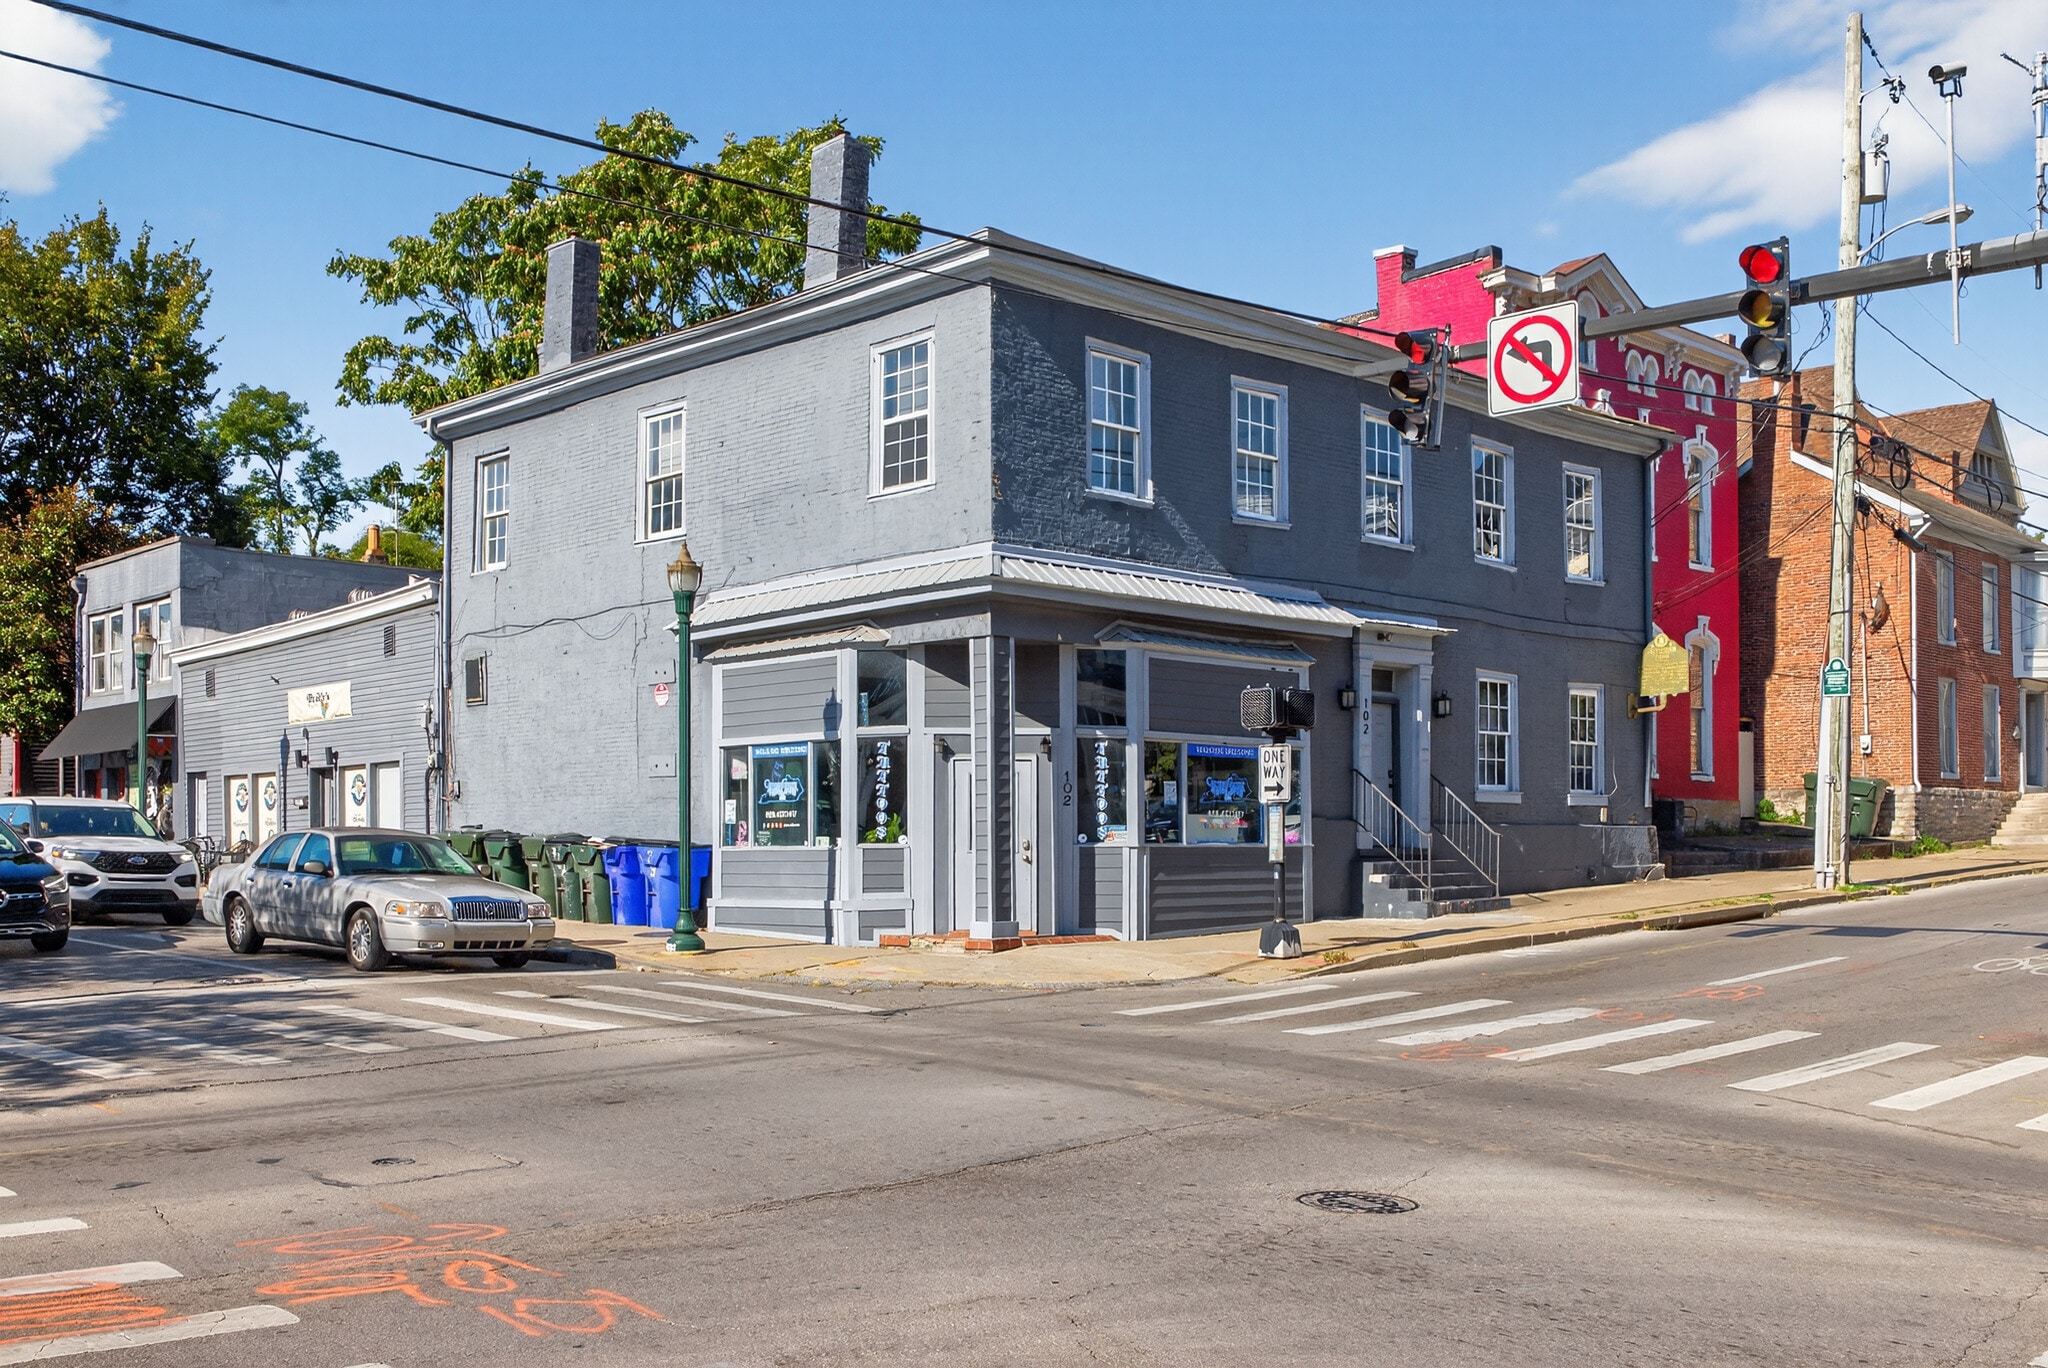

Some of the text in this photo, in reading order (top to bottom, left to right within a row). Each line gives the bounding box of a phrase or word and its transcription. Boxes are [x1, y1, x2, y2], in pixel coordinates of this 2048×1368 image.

[1264, 750, 1286, 763] ONE
[1264, 766, 1286, 779] WAY
[1063, 770, 1073, 806] 102
